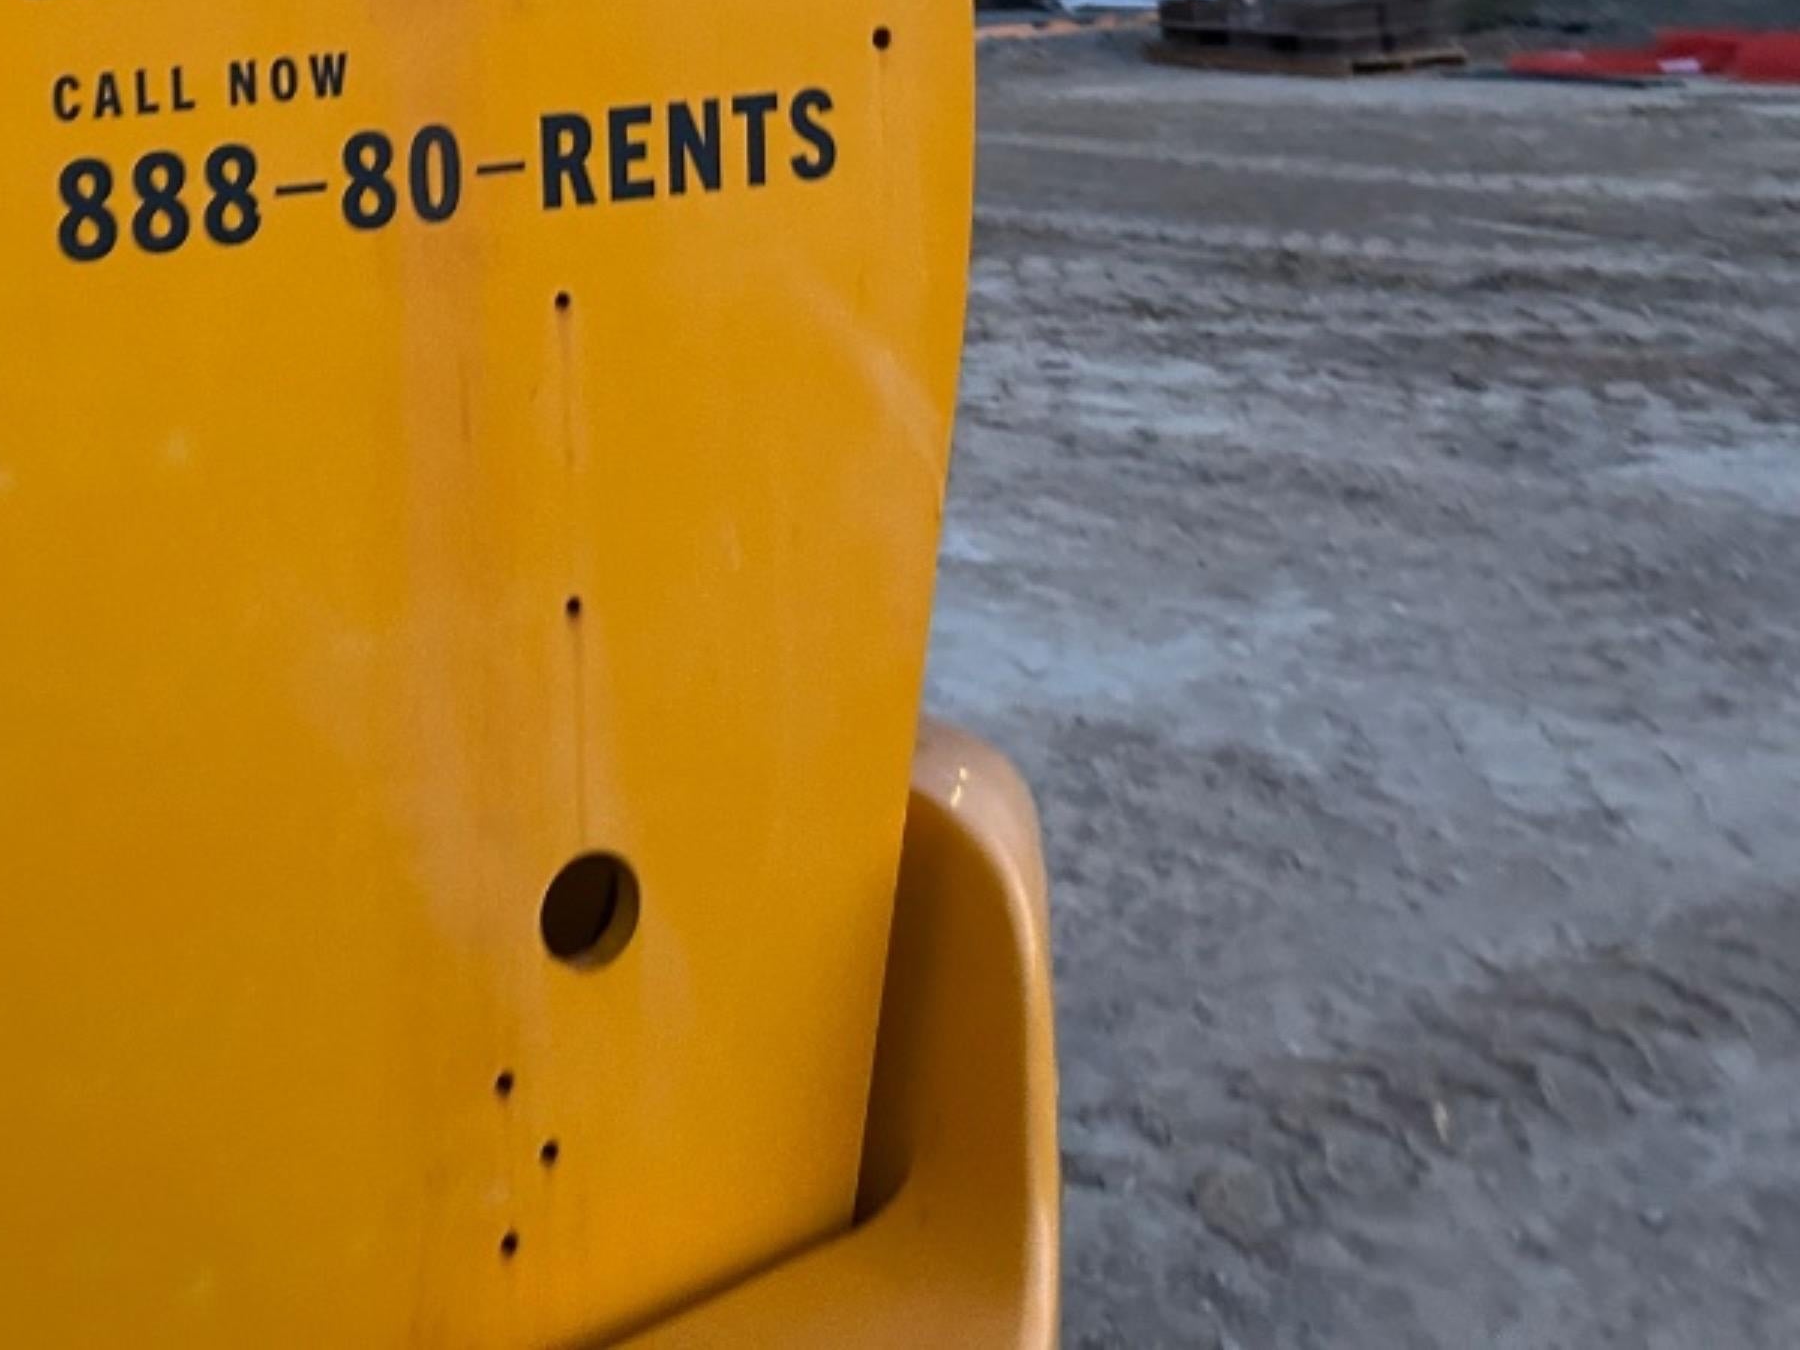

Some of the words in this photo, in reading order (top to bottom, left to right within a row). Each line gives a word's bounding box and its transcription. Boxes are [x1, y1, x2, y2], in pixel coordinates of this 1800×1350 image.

[52, 64, 196, 121] CALL
[229, 53, 348, 106] NOW
[57, 89, 837, 261] 888-80-RENTS
